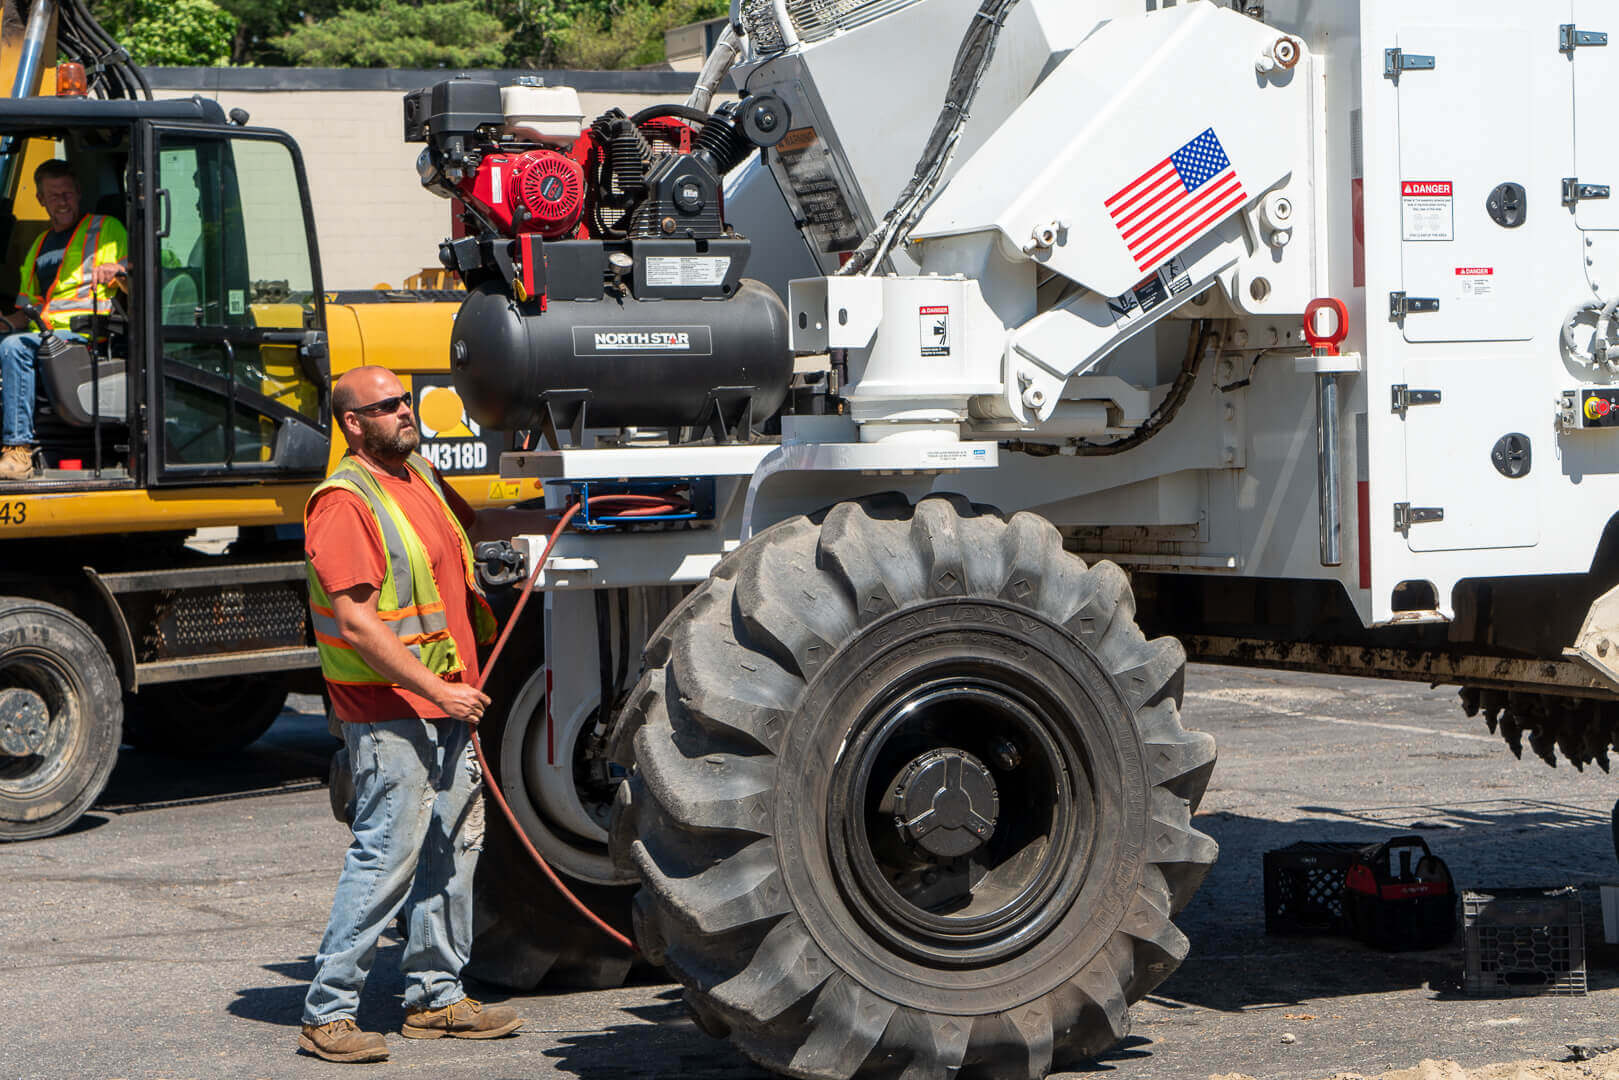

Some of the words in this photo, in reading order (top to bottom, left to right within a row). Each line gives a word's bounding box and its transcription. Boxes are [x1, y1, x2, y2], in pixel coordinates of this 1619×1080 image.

[1413, 184, 1450, 194] DANGER
[420, 442, 487, 471] M318D
[872, 606, 1042, 647] GALAXY
